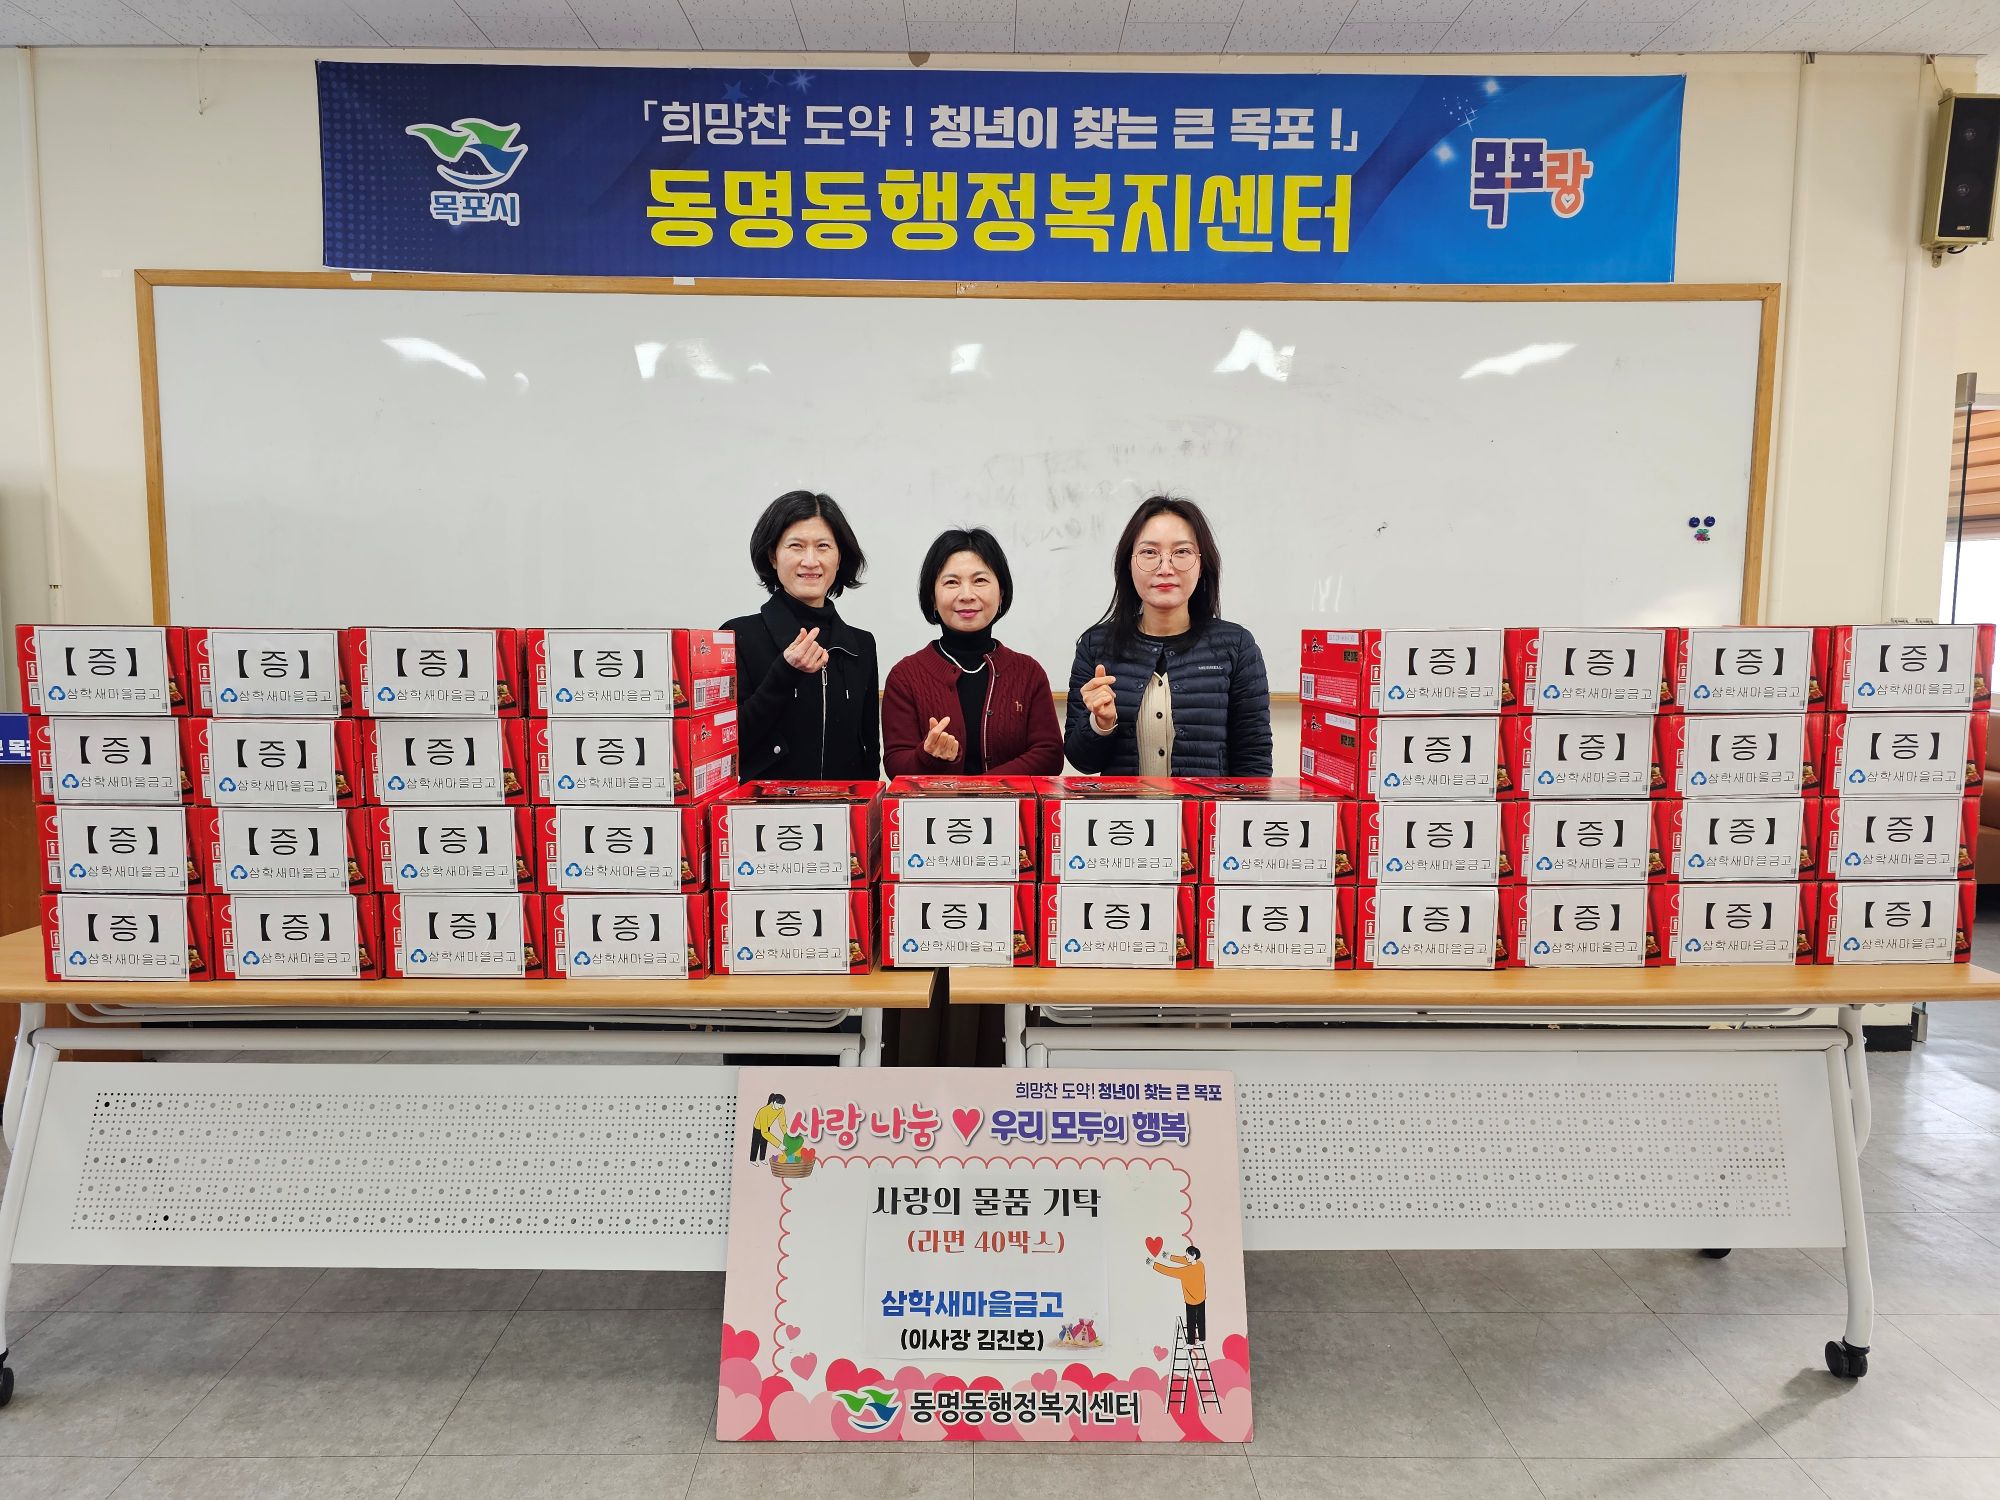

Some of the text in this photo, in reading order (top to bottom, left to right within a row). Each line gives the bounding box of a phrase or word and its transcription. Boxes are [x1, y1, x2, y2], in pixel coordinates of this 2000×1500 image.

[804, 106, 891, 149] 도약
[930, 104, 1058, 150] 청년이
[1073, 107, 1158, 150] 찾는
[1173, 107, 1214, 150] 큰
[1230, 107, 1316, 151] 목포
[1471, 138, 1594, 229] 목포랑
[431, 190, 521, 227] 목포시
[647, 168, 1352, 254] 동명동행정복지센터
[66, 687, 160, 700] 삼학새마을금고
[1406, 686, 1494, 699] 삼학새마을금고
[1563, 687, 1654, 701] 삼학새마을금고
[1713, 686, 1803, 698] 삼학새마을금고
[1877, 683, 1967, 695] 삼학새마을금고
[238, 690, 333, 704] 삼학새마을금고
[396, 689, 491, 703] 삼학새마을금고
[573, 690, 666, 702] 삼학새마을금고
[81, 775, 175, 788] 삼학새마을금고
[575, 776, 666, 788] 삼학새마을금고
[1403, 774, 1491, 786] 삼학새마을금고
[1556, 771, 1644, 784] 삼학새마을금고
[1708, 770, 1796, 784] 삼학새마을금고
[1868, 770, 1959, 782] 삼학새마을금고
[236, 779, 329, 792] 삼학새마을금고
[405, 777, 496, 790] 삼학새마을금고
[925, 855, 1012, 867] 삼학새마을금고
[1087, 857, 1174, 869] 삼학새마을금고
[1240, 858, 1328, 870] 삼학새마을금고
[1554, 858, 1642, 870] 삼학새마을금고
[1707, 854, 1794, 866] 삼학새마을금고
[1863, 852, 1952, 864] 삼학새마을금고
[87, 864, 180, 878] 삼학새마을금고
[418, 865, 509, 878] 삼학새마을금고
[584, 864, 674, 878] 삼학새마을금고
[755, 862, 843, 874] 삼학새마을금고
[1404, 859, 1493, 871] 삼학새마을금고
[248, 867, 341, 880] 삼학새마을금고
[920, 940, 1007, 953] 삼학새마을금고
[1082, 940, 1169, 953] 삼학새마을금고
[1240, 943, 1328, 955] 삼학새마을금고
[1400, 943, 1488, 955] 삼학새마을금고
[1552, 942, 1639, 954] 삼학새마을금고
[1703, 940, 1790, 952] 삼학새마을금고
[1863, 938, 1950, 951] 삼학새마을금고
[87, 952, 181, 966] 삼학새마을금고
[260, 952, 352, 964] 삼학새마을금고
[428, 950, 518, 964] 삼학새마을금고
[591, 952, 680, 964] 삼학새마을금고
[754, 947, 842, 960] 삼학새마을금고
[1015, 1081, 1222, 1102] 희망찬 도약! 청년이 찾는 큰 목포
[788, 1103, 1190, 1149] 사랑 나눔 우리 모두의 행복
[872, 1186, 1102, 1218] 사랑의 물품 기탁
[907, 1229, 1066, 1255] (라면 40박스)
[880, 1290, 1065, 1319] 삼학새마을금고
[900, 1328, 971, 1352] (이사장
[977, 1328, 1045, 1353] 김진호)
[909, 1390, 1141, 1425] 동명동행정복지센터
